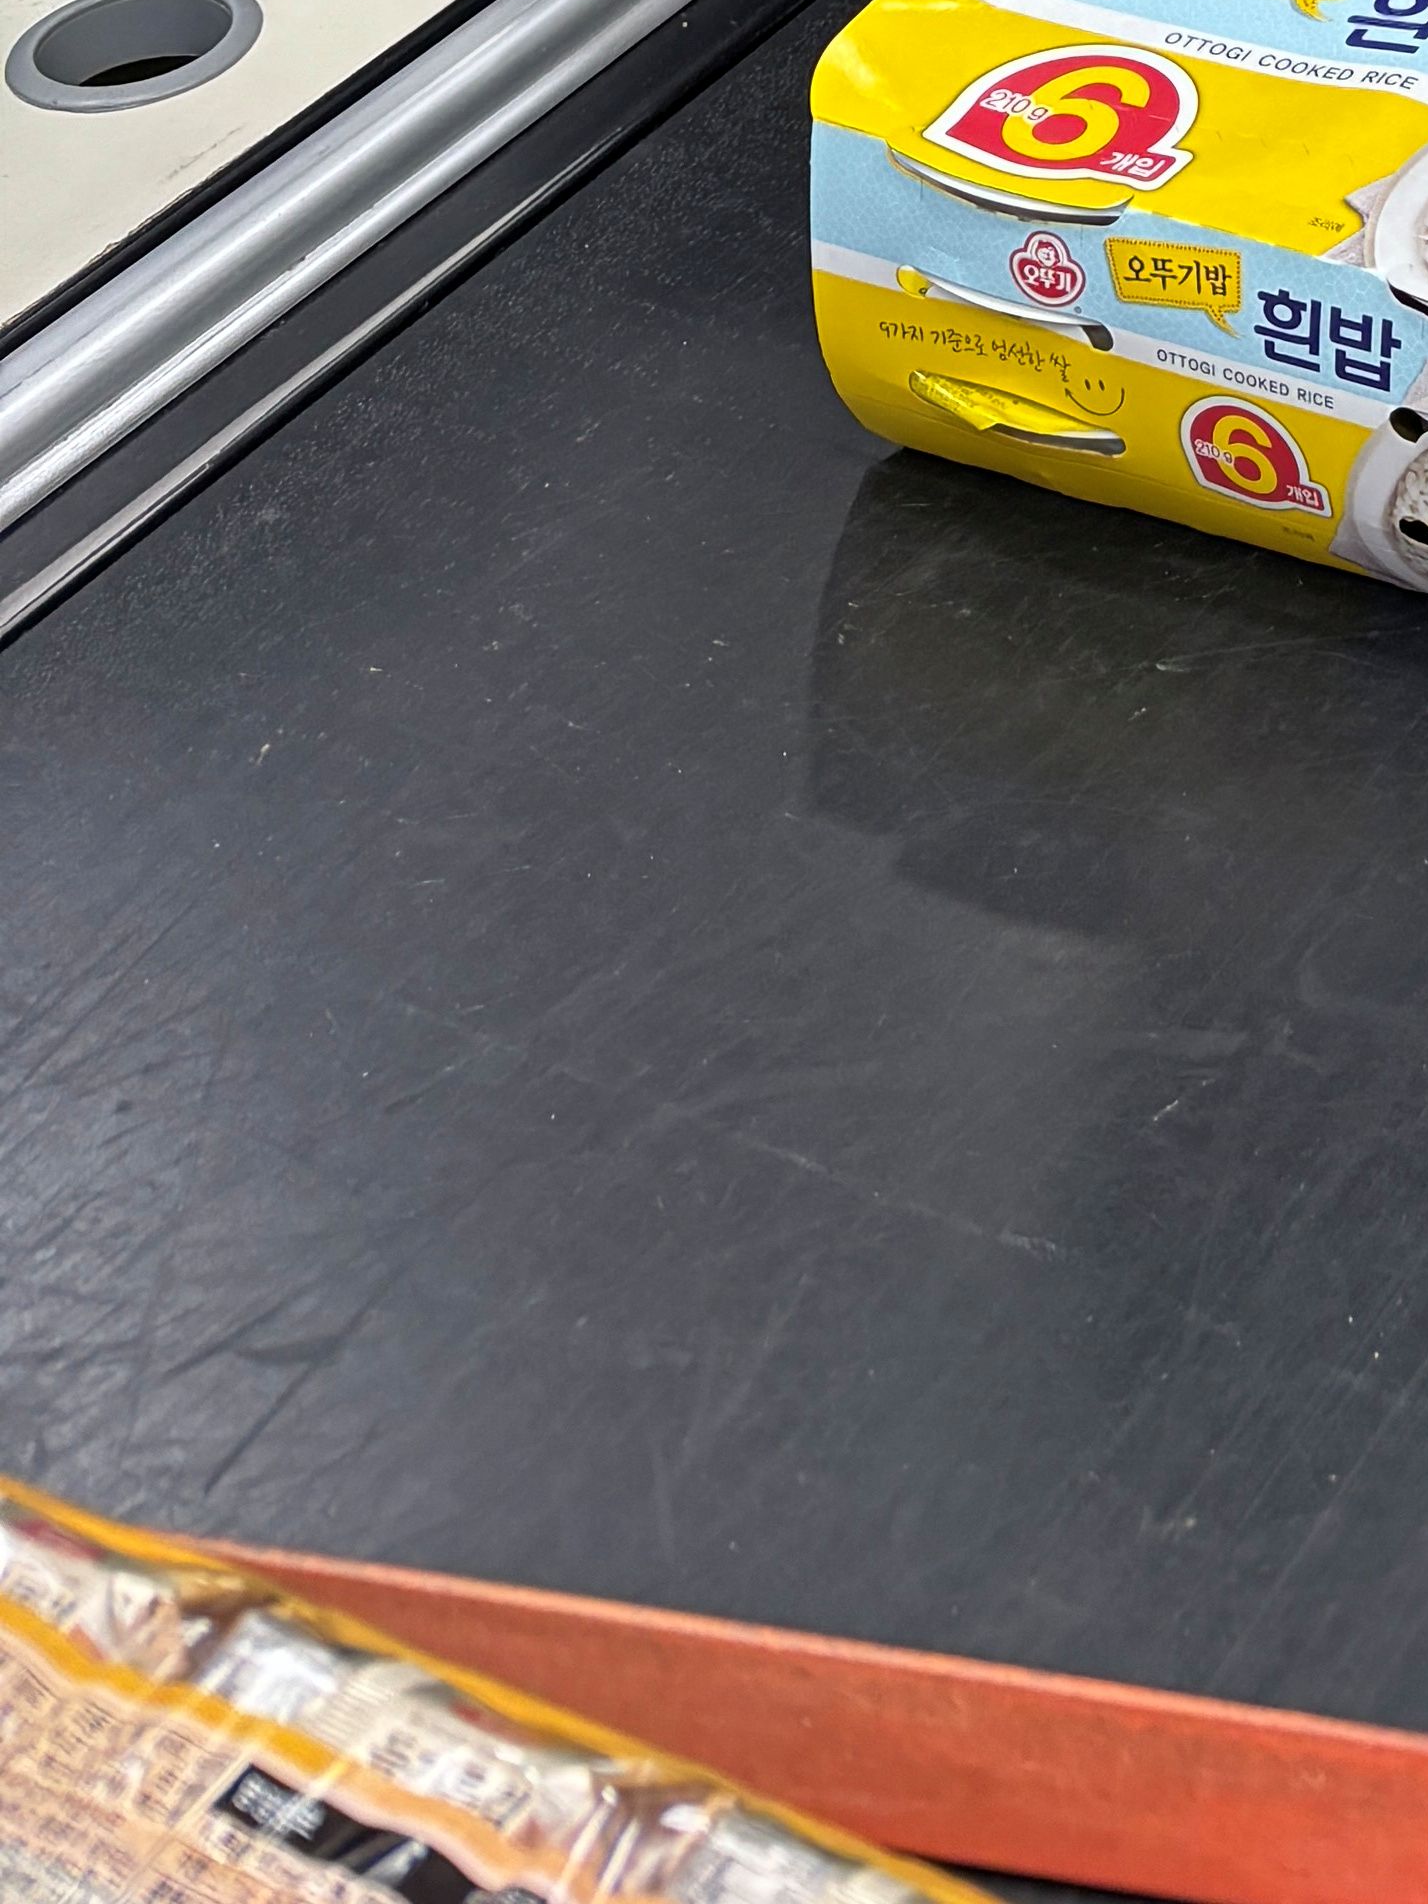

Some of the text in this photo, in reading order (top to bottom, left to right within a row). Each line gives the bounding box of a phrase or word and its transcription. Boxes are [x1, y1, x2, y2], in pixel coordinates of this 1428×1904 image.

[1166, 31, 1418, 91] OTTOGI COOKED RICE
[979, 90, 1028, 116] 210
[1002, 65, 1152, 161] 6
[1099, 150, 1166, 178] 개입
[1022, 263, 1073, 293] 오뚜기
[1123, 255, 1232, 298] 오뚜기밥
[878, 320, 1073, 382] 9가지 기준으로 엄선한 쌀
[1253, 288, 1402, 393] 흰밥
[1156, 349, 1335, 409] OTTOGI COOKED RICE
[1194, 438, 1221, 459] 210
[1213, 414, 1278, 495] 6
[1286, 484, 1320, 508] 개입
